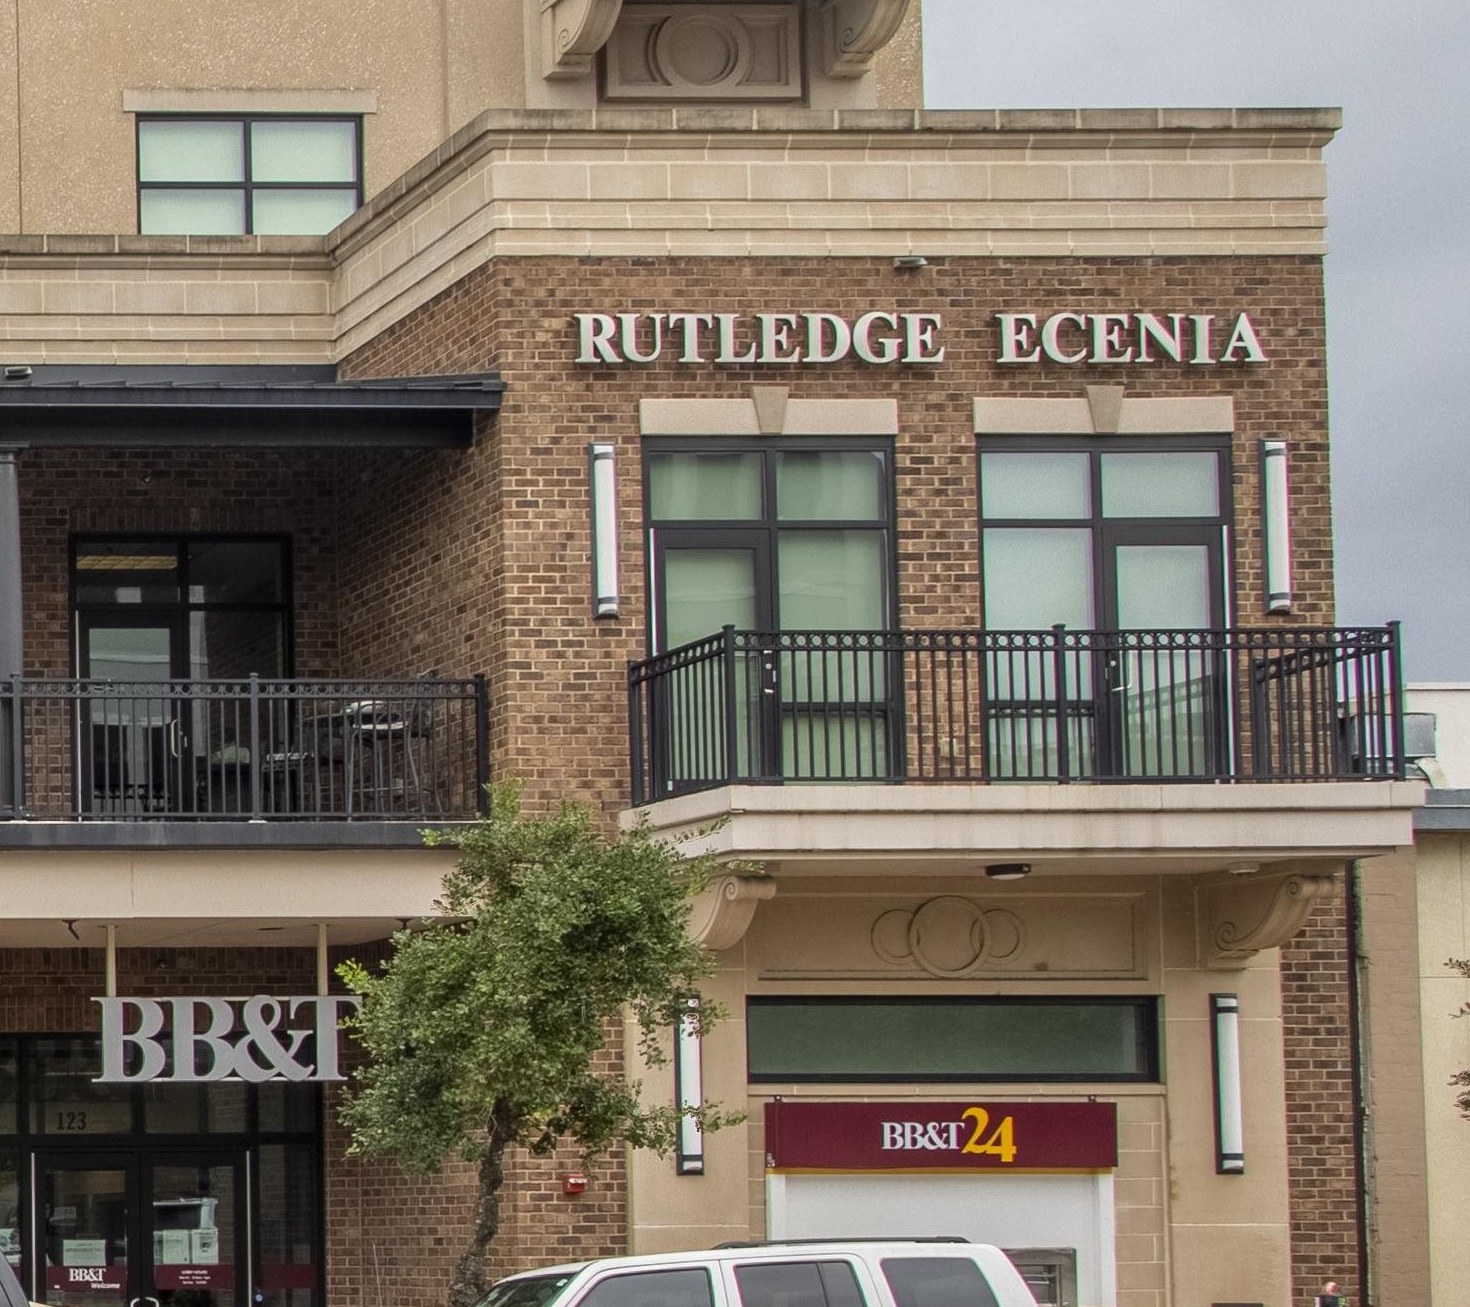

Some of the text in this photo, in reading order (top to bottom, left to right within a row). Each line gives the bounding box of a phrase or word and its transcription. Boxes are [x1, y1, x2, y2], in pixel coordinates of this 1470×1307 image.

[573, 311, 1268, 365] RUTLEDGE ECENIA
[90, 994, 363, 1084] BB&T
[56, 1110, 87, 1131] 123
[68, 1268, 107, 1282] BB&T
